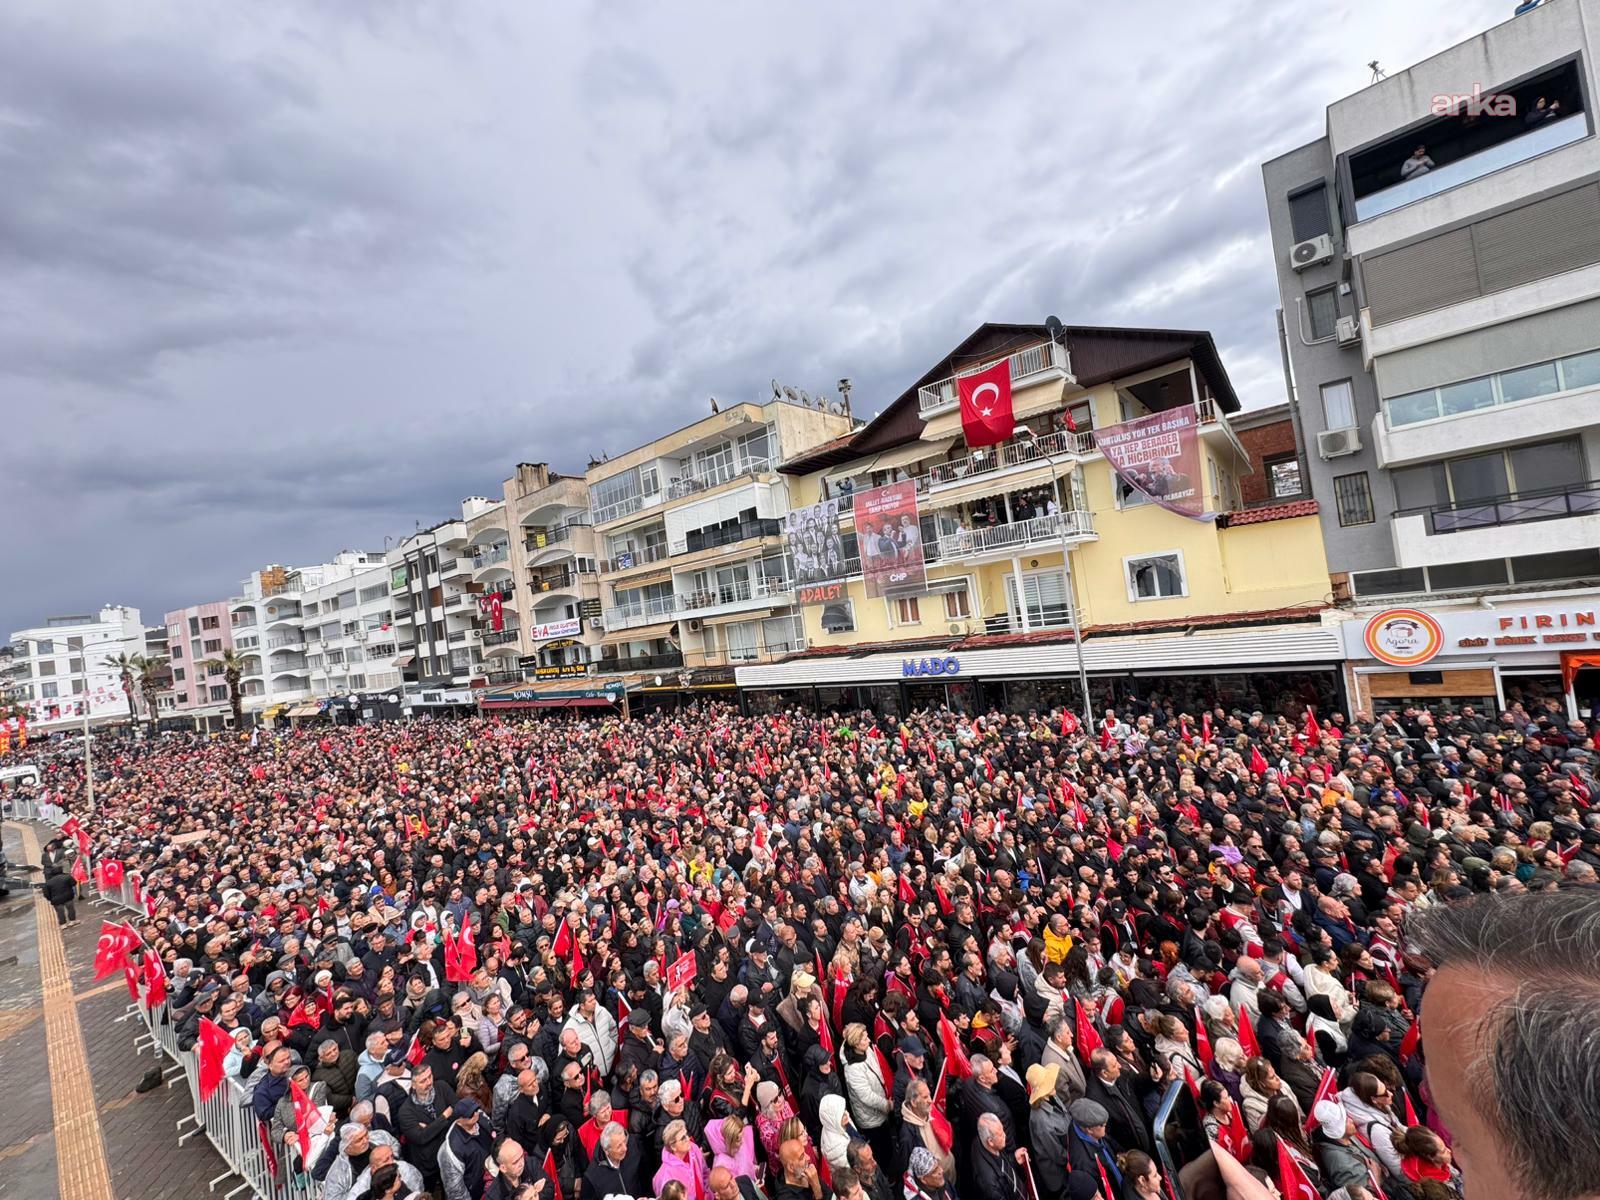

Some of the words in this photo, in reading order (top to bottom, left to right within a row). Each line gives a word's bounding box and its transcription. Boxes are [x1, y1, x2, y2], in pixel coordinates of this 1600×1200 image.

[1132, 429, 1147, 440] YOK
[1147, 425, 1160, 435] TEK
[1162, 416, 1190, 430] BAŞINA
[1111, 446, 1122, 457] YA
[1125, 443, 1139, 454] HEP
[1141, 433, 1178, 449] BERABER
[890, 573, 907, 582] CHP
[800, 585, 842, 603] ADALET
[1499, 612, 1596, 631] FIRIN
[1458, 637, 1489, 648] SİMİT
[1494, 635, 1538, 646] BÖREK
[902, 656, 960, 677] MADO
